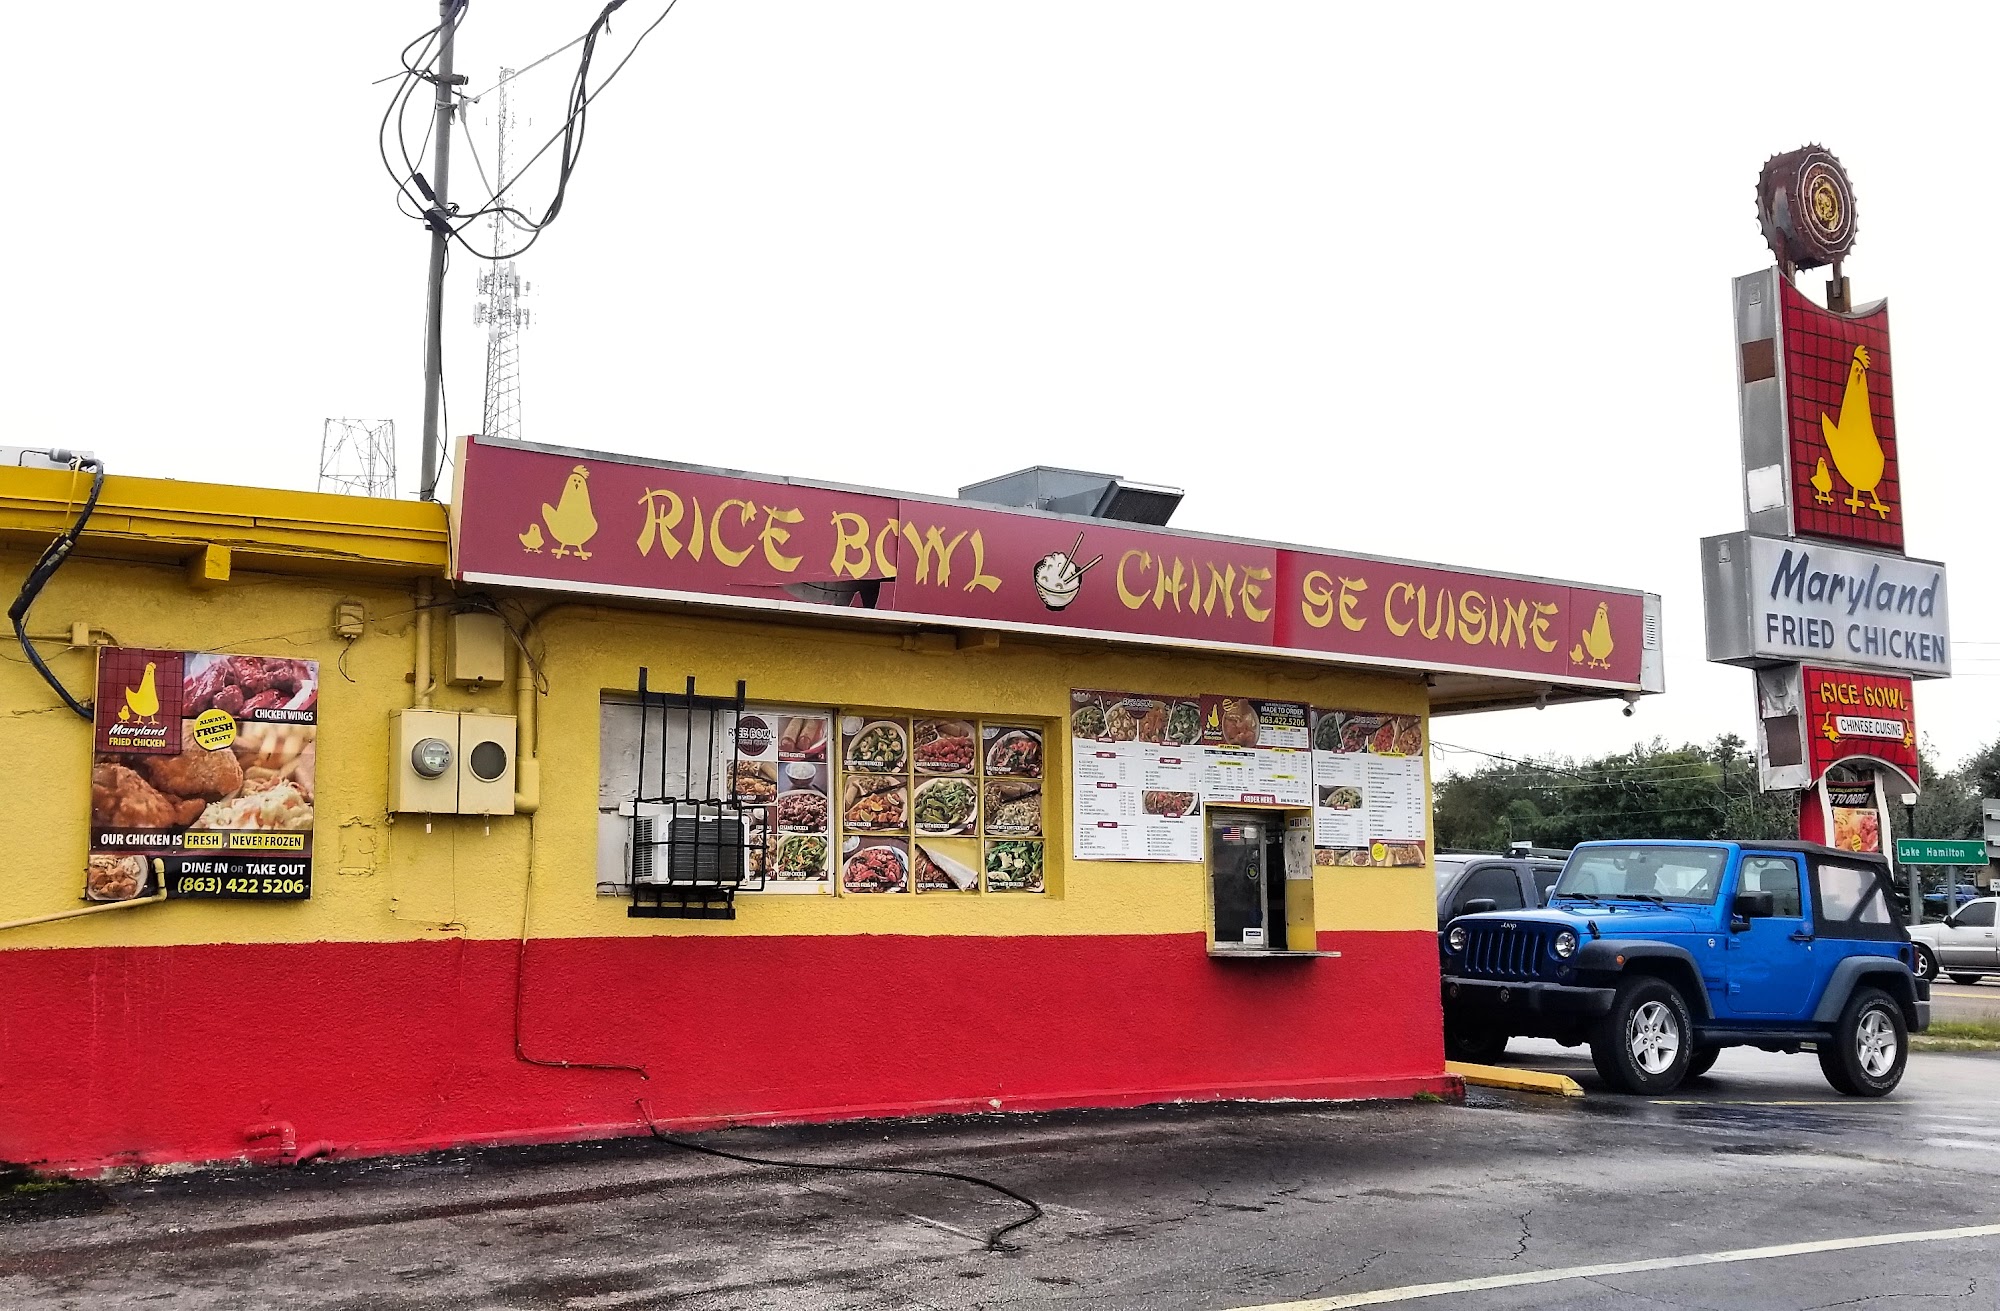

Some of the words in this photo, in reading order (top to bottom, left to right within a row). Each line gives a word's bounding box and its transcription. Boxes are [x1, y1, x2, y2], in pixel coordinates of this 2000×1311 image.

[636, 486, 804, 573] RICE
[830, 511, 1002, 593] BOWL
[1770, 548, 1940, 617] Maryland
[1384, 582, 1559, 653] CUISINE
[1766, 613, 1835, 650] FRIED
[1847, 623, 1945, 664] CHICKEN
[1820, 682, 1860, 706] RICE
[1863, 685, 1909, 712] BOWL
[199, 715, 227, 726] ALWAYS
[255, 709, 286, 720] CHICKEN
[287, 711, 314, 722] WINGS
[108, 723, 167, 737] Maryland
[195, 722, 234, 738] FRESH
[1840, 718, 1873, 734] CHINESE
[1874, 721, 1902, 737] CUISINE
[108, 737, 132, 747] FRIED
[132, 738, 166, 747] CHICKEN
[210, 733, 232, 743] TASTY
[100, 833, 124, 845] OUR
[125, 833, 170, 846] CHICKEN
[172, 834, 182, 845] IS
[187, 834, 219, 846] FRESH
[232, 835, 262, 847] NEVER
[264, 836, 301, 847] FROZEN
[1900, 846, 1920, 857] Lake
[1926, 847, 1965, 858] Hamilton
[181, 862, 212, 873] DINE
[214, 863, 228, 873] IN
[230, 865, 244, 873] OR
[246, 863, 276, 875] TAKE
[278, 864, 306, 875] OUT
[177, 876, 222, 895] (863)
[226, 878, 258, 893] 422
[262, 878, 304, 893] 5206
